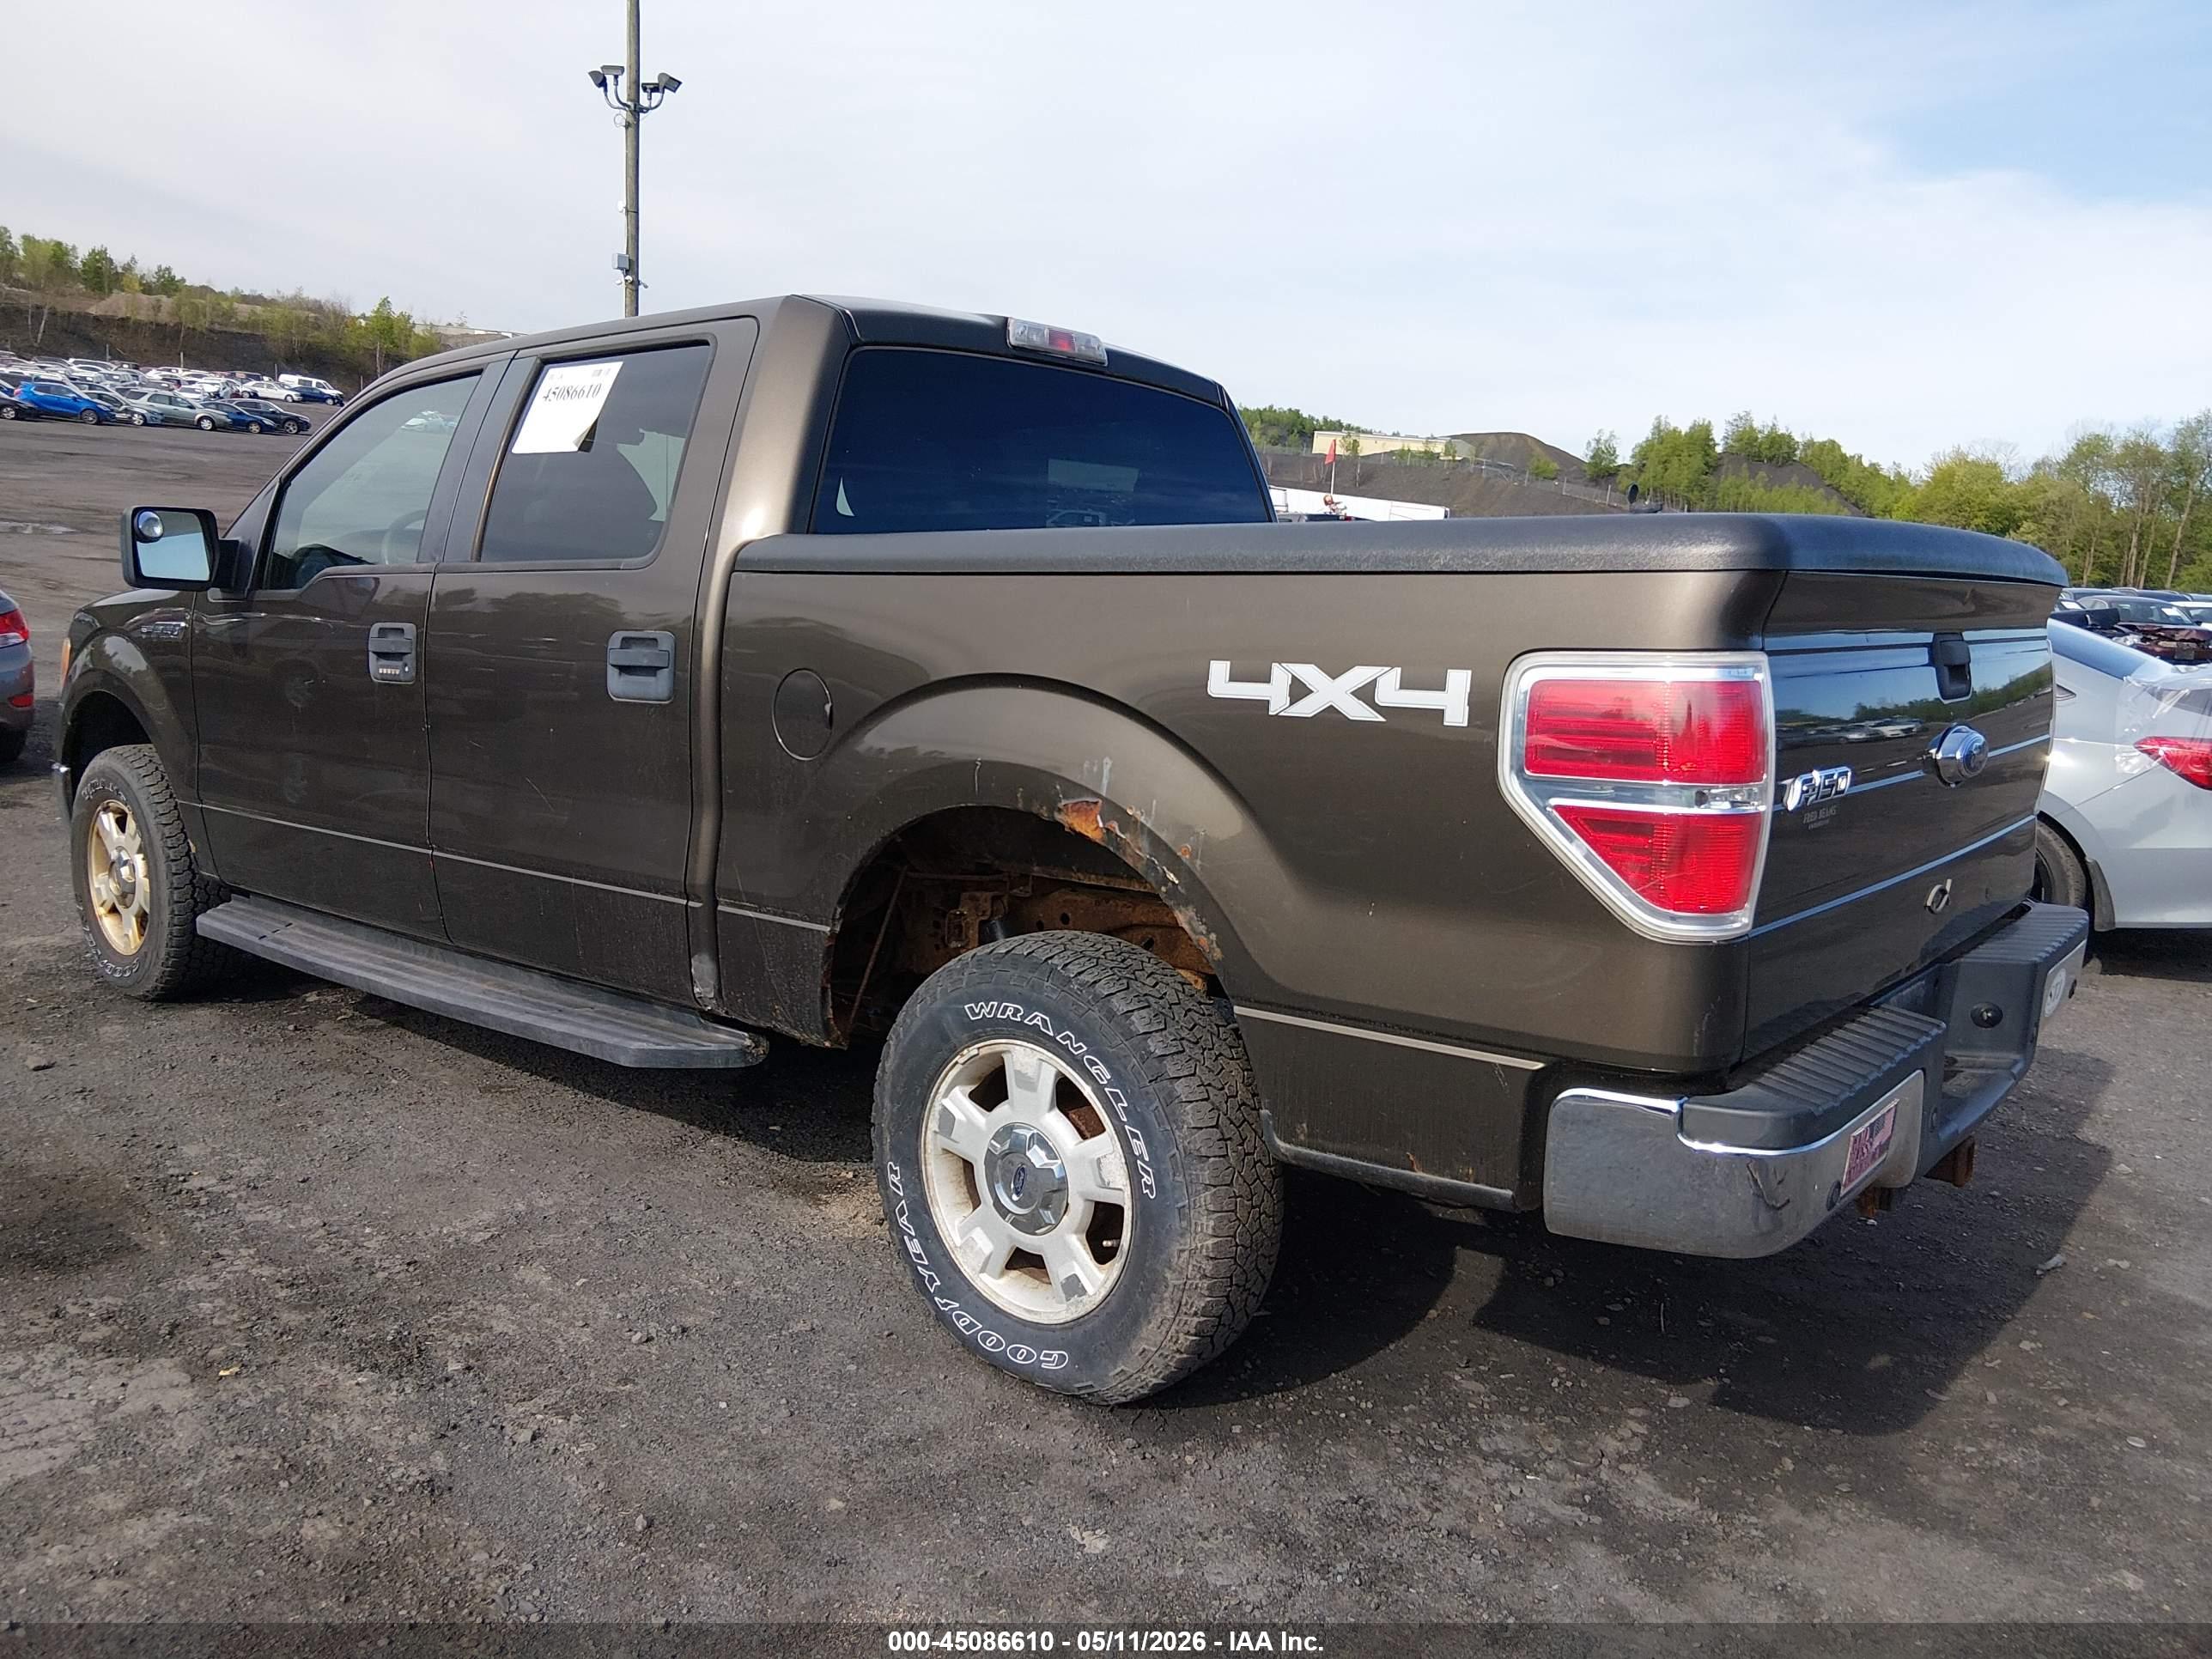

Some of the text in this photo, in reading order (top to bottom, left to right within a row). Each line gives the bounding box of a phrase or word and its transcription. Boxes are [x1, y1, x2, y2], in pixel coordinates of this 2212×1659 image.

[543, 383, 603, 402] 45086610
[963, 1001, 1157, 1200] WRANGLER
[887, 1161, 1069, 1370] GOODYEAR
